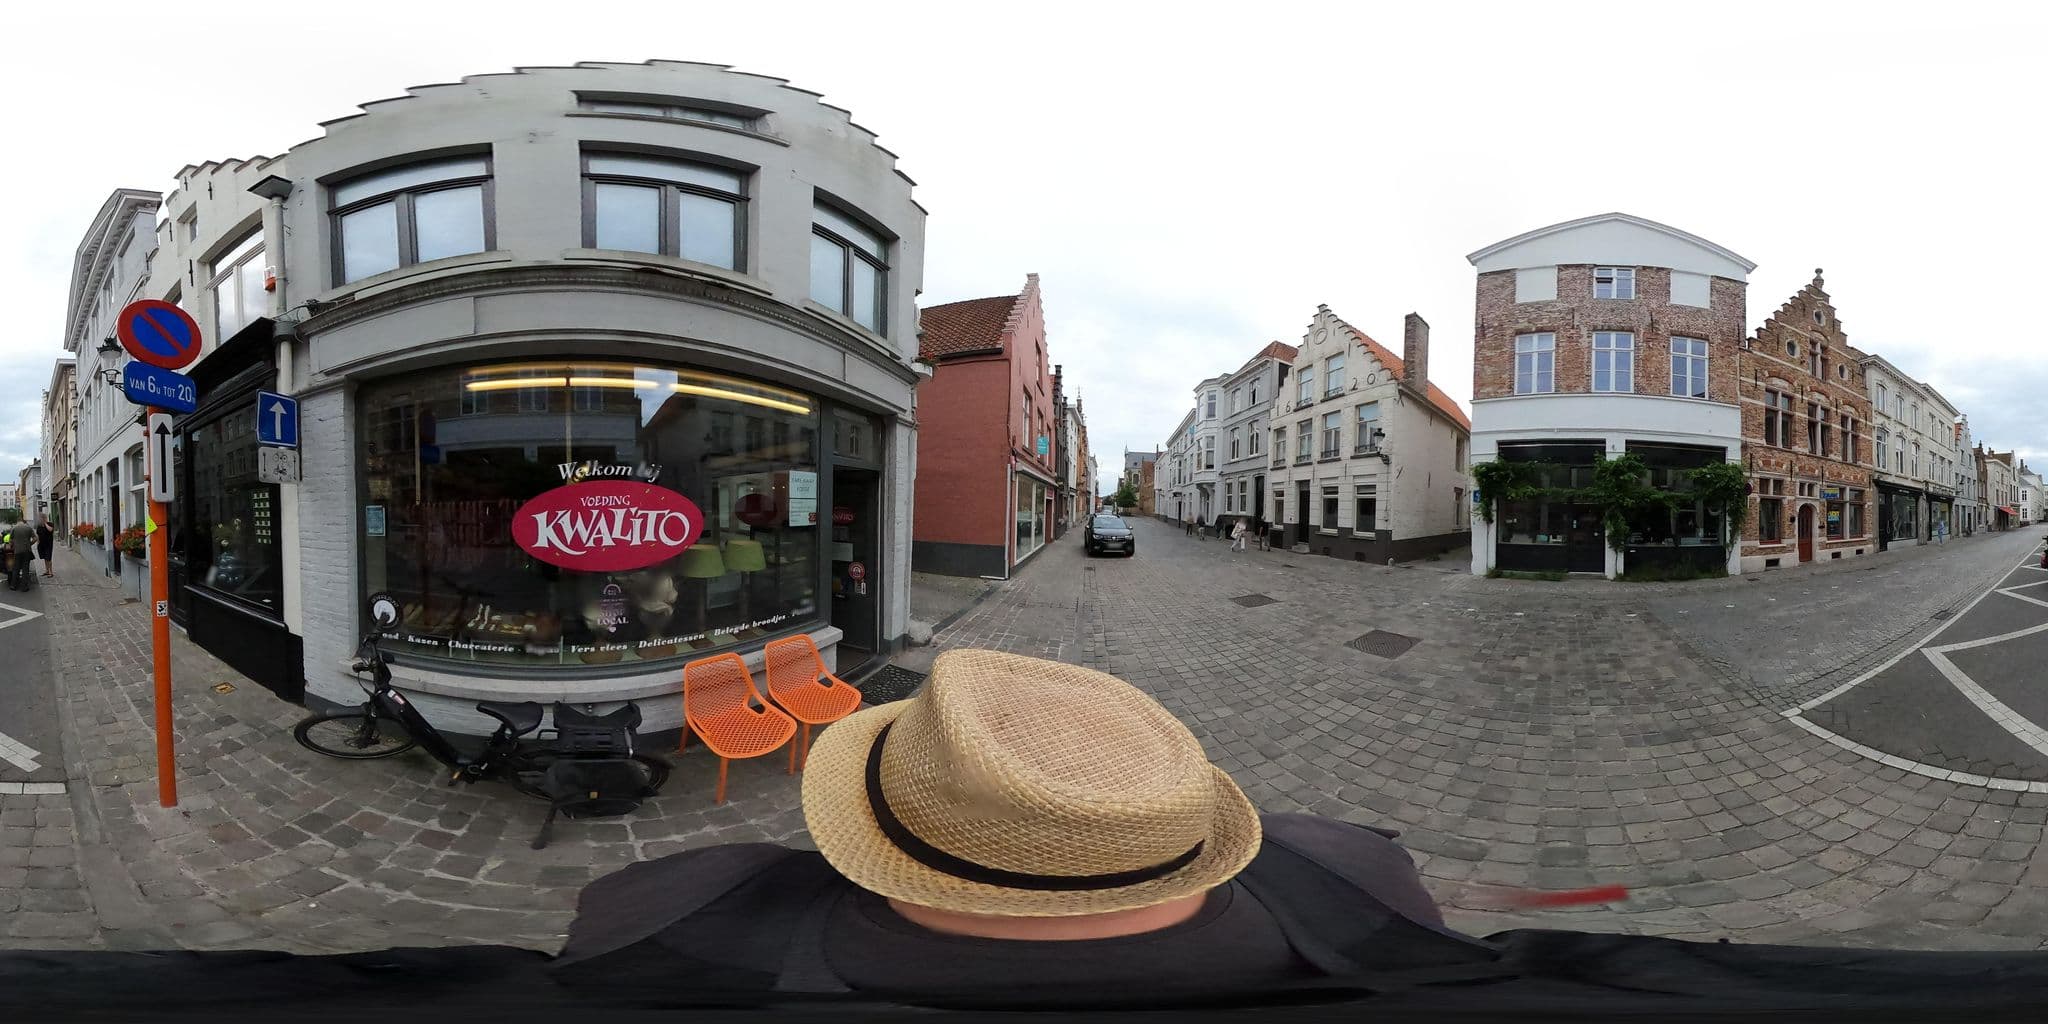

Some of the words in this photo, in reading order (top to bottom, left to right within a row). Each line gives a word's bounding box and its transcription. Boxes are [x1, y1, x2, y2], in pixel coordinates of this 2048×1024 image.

[130, 377, 145, 390] VAN
[163, 386, 176, 398] TOT
[558, 460, 633, 480] Welkom
[580, 495, 631, 506] VOEDING
[597, 616, 629, 625] LOCAL
[714, 624, 750, 636] Belegde
[752, 614, 786, 627] broodjes
[571, 644, 595, 653] Vers
[638, 633, 705, 648] Delicatessen
